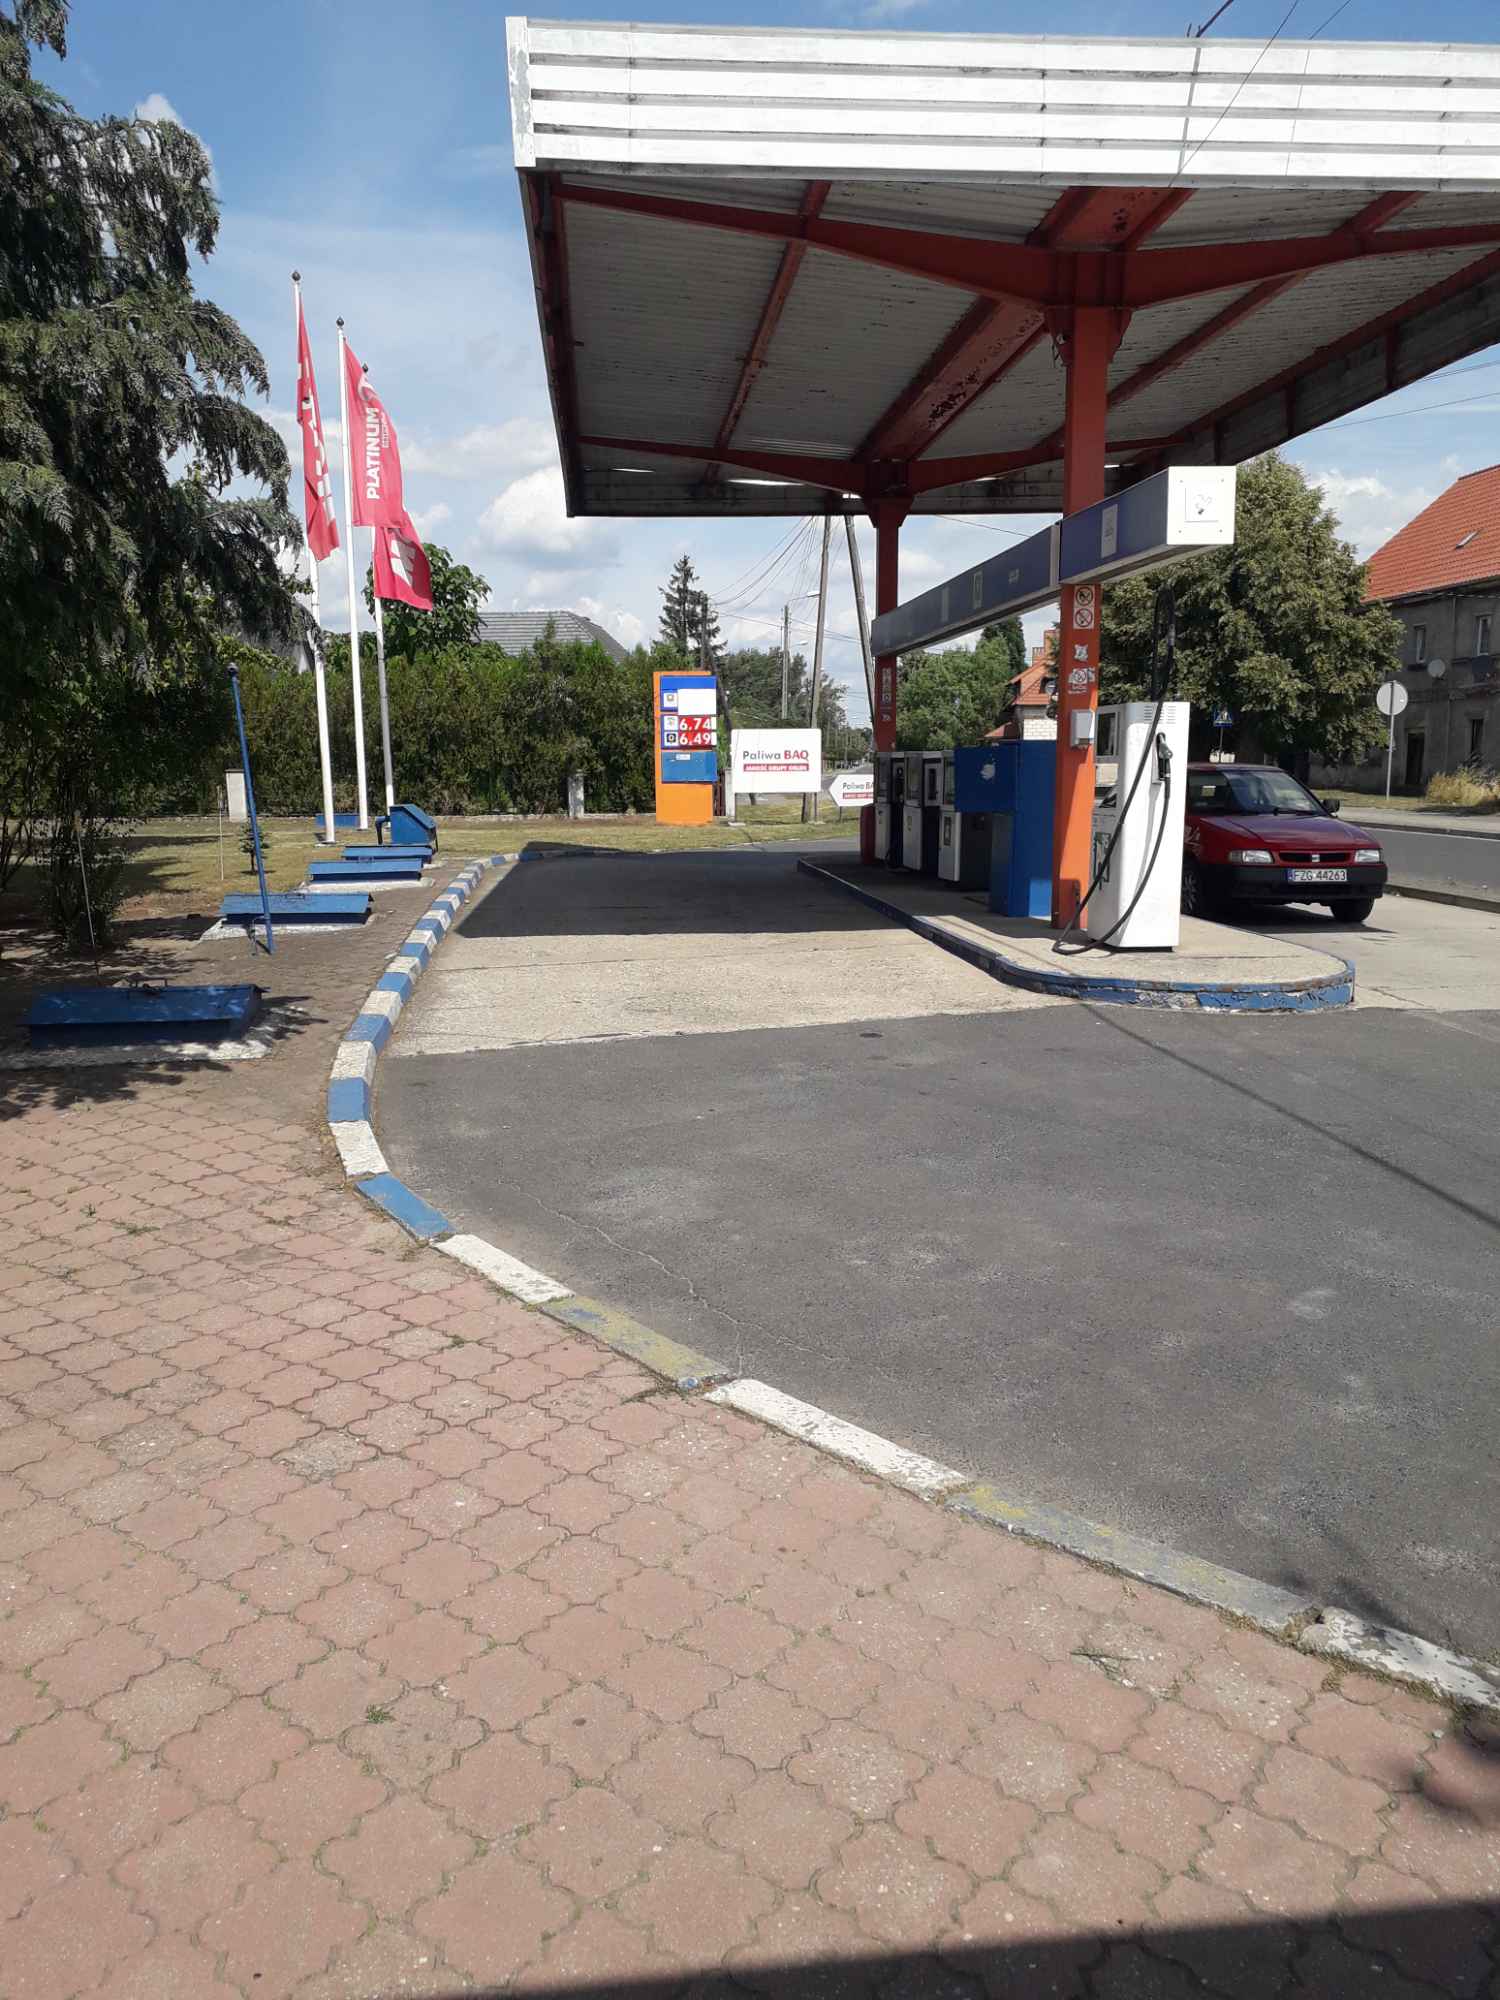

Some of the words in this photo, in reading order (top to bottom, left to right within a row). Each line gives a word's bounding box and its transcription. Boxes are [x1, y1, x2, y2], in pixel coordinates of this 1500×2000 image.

[366, 407, 380, 500] PLATINUM
[743, 750, 781, 760] Paliwa
[783, 750, 809, 761] BAQ
[1294, 870, 1313, 881] FZG
[1316, 870, 1346, 881] 44263
